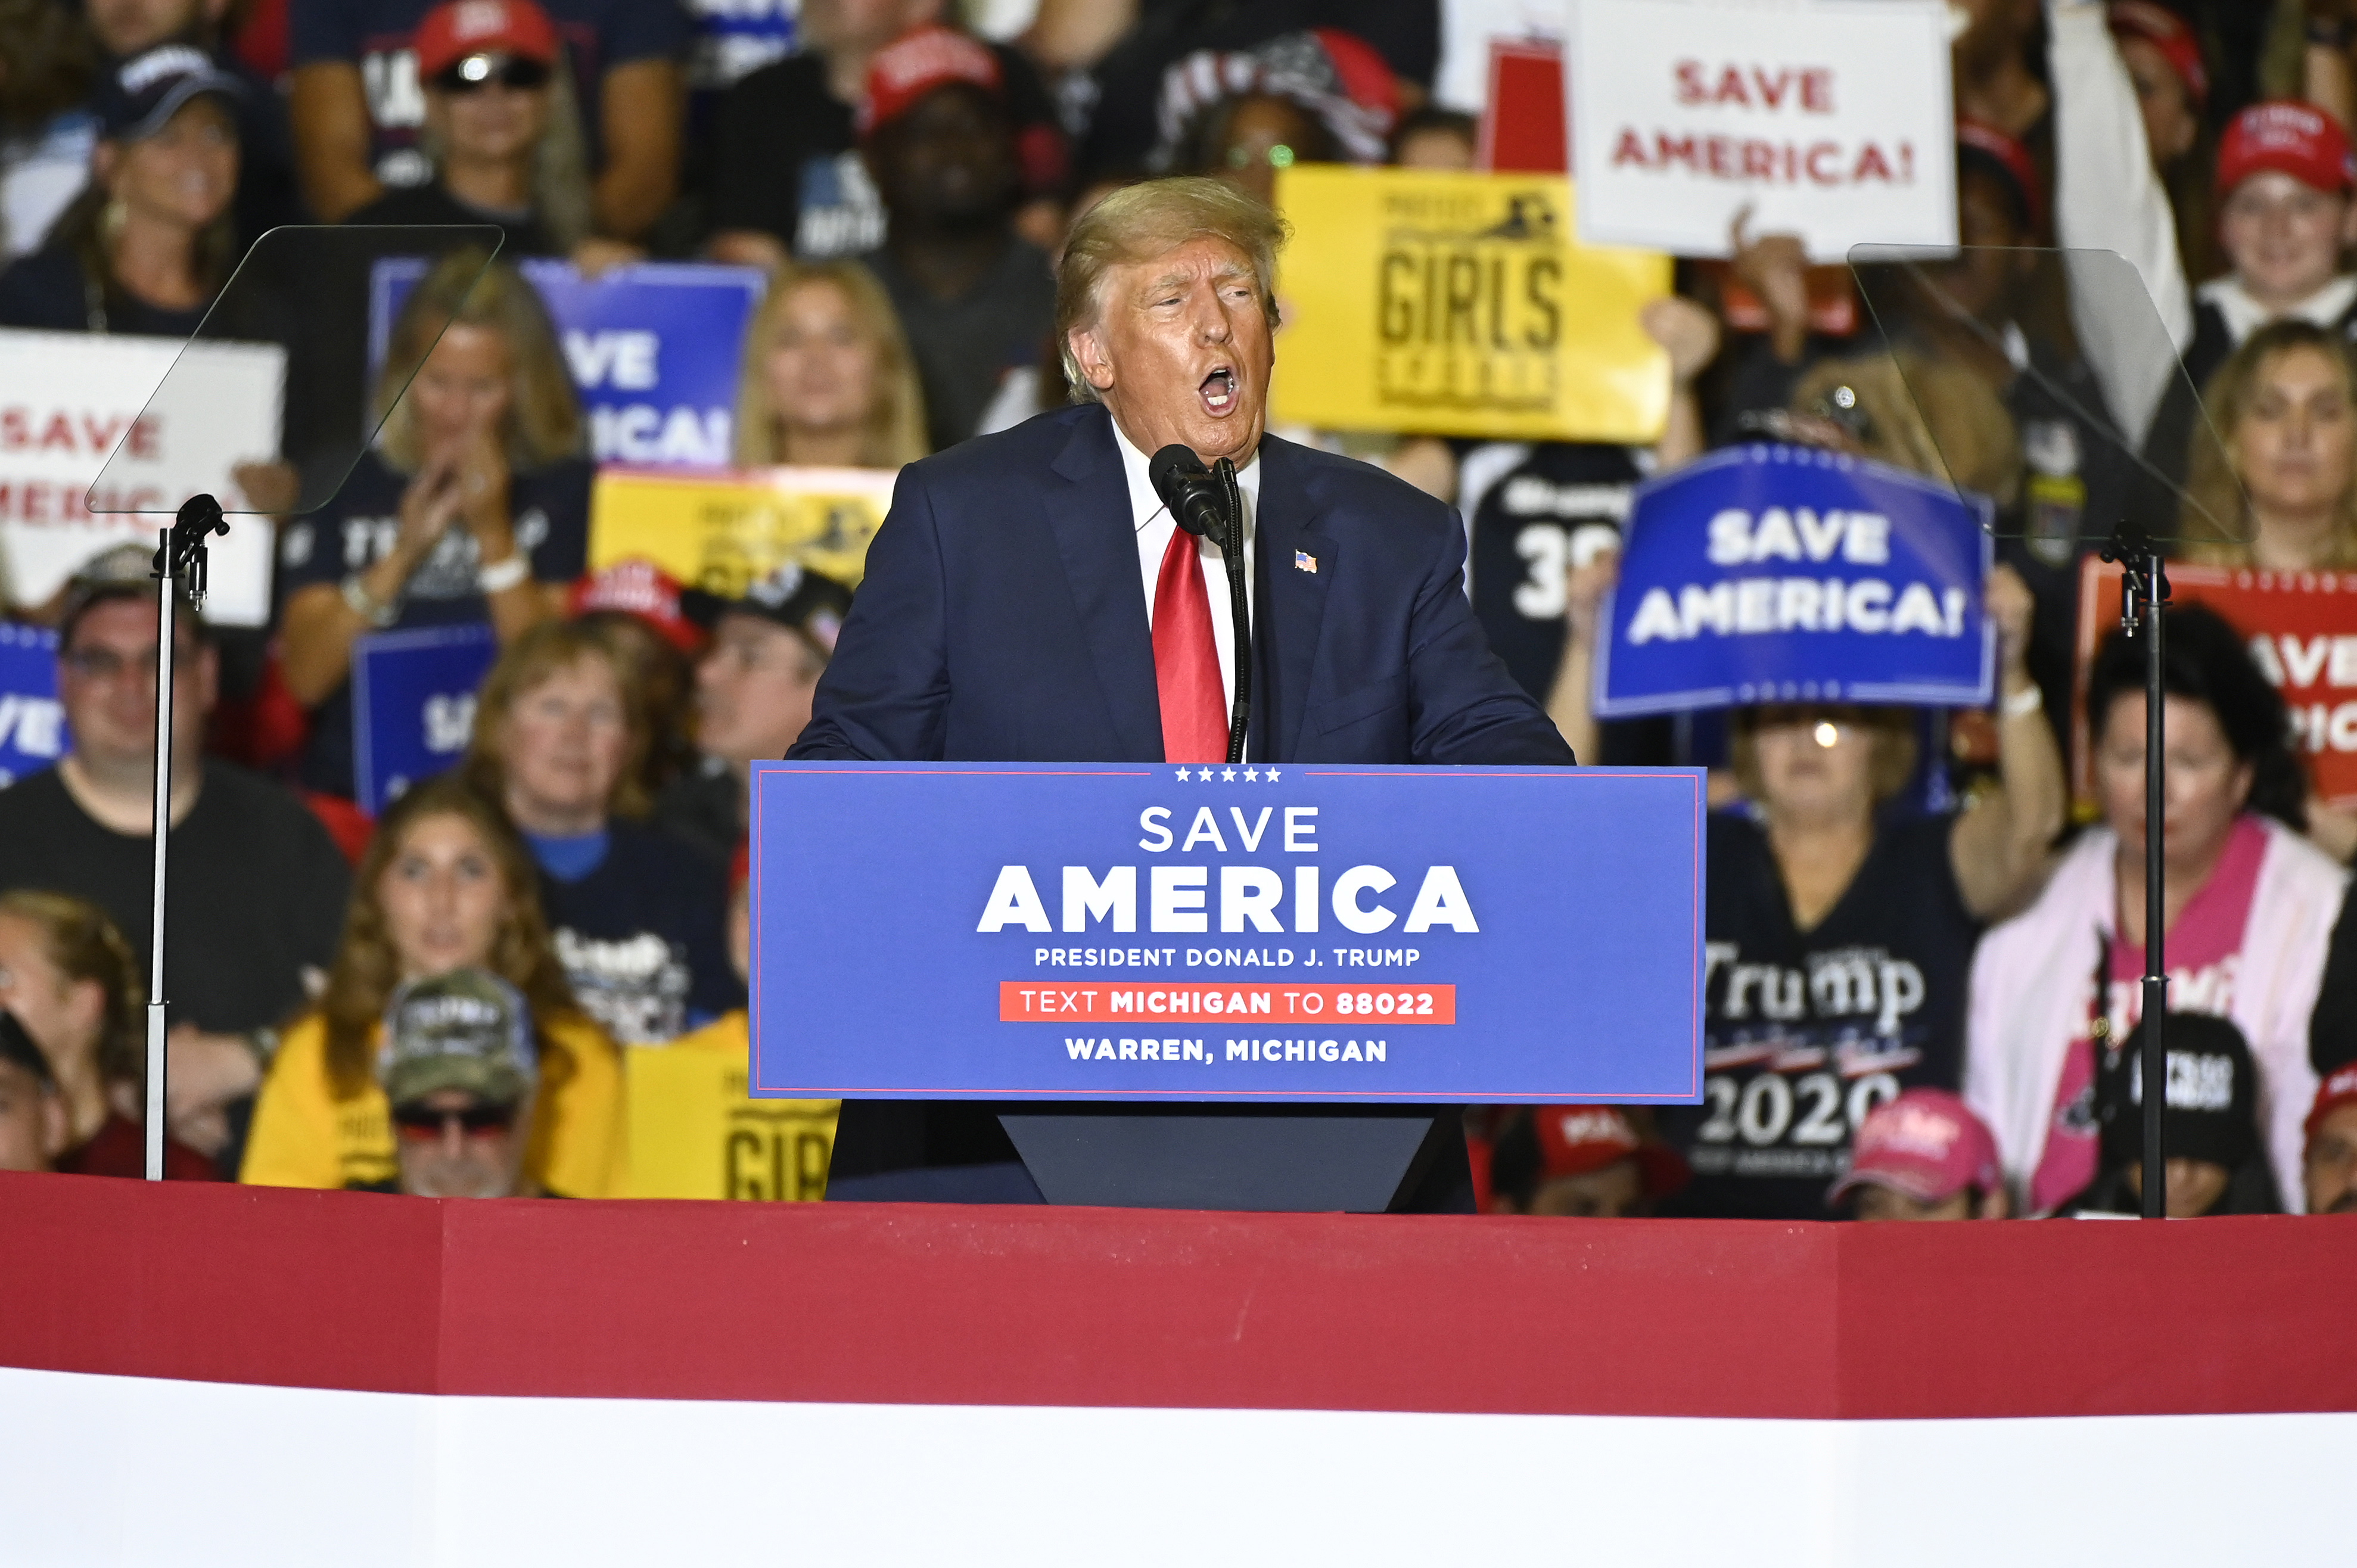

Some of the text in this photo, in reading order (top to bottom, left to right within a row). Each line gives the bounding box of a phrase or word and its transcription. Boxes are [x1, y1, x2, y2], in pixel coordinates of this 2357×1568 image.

[1673, 58, 1836, 114] SAVE
[1611, 129, 1915, 186] AMERICA!
[1379, 250, 1562, 351] GIRLS
[0, 406, 164, 461] SAVE
[0, 478, 203, 535] ERIC
[1706, 506, 1891, 566] SAVE
[1625, 575, 1966, 646] AMERICA!
[1138, 805, 1319, 853] SAVE
[975, 864, 1480, 935] AMERICA
[1036, 947, 1419, 966] PRESIDENT DONALD J. TRUMP
[1019, 990, 1433, 1015] TEXT MICHIGAN TO 88022
[1704, 941, 1927, 1038] Trump
[1064, 1038, 1386, 1065] WARREN, MICHIGAN
